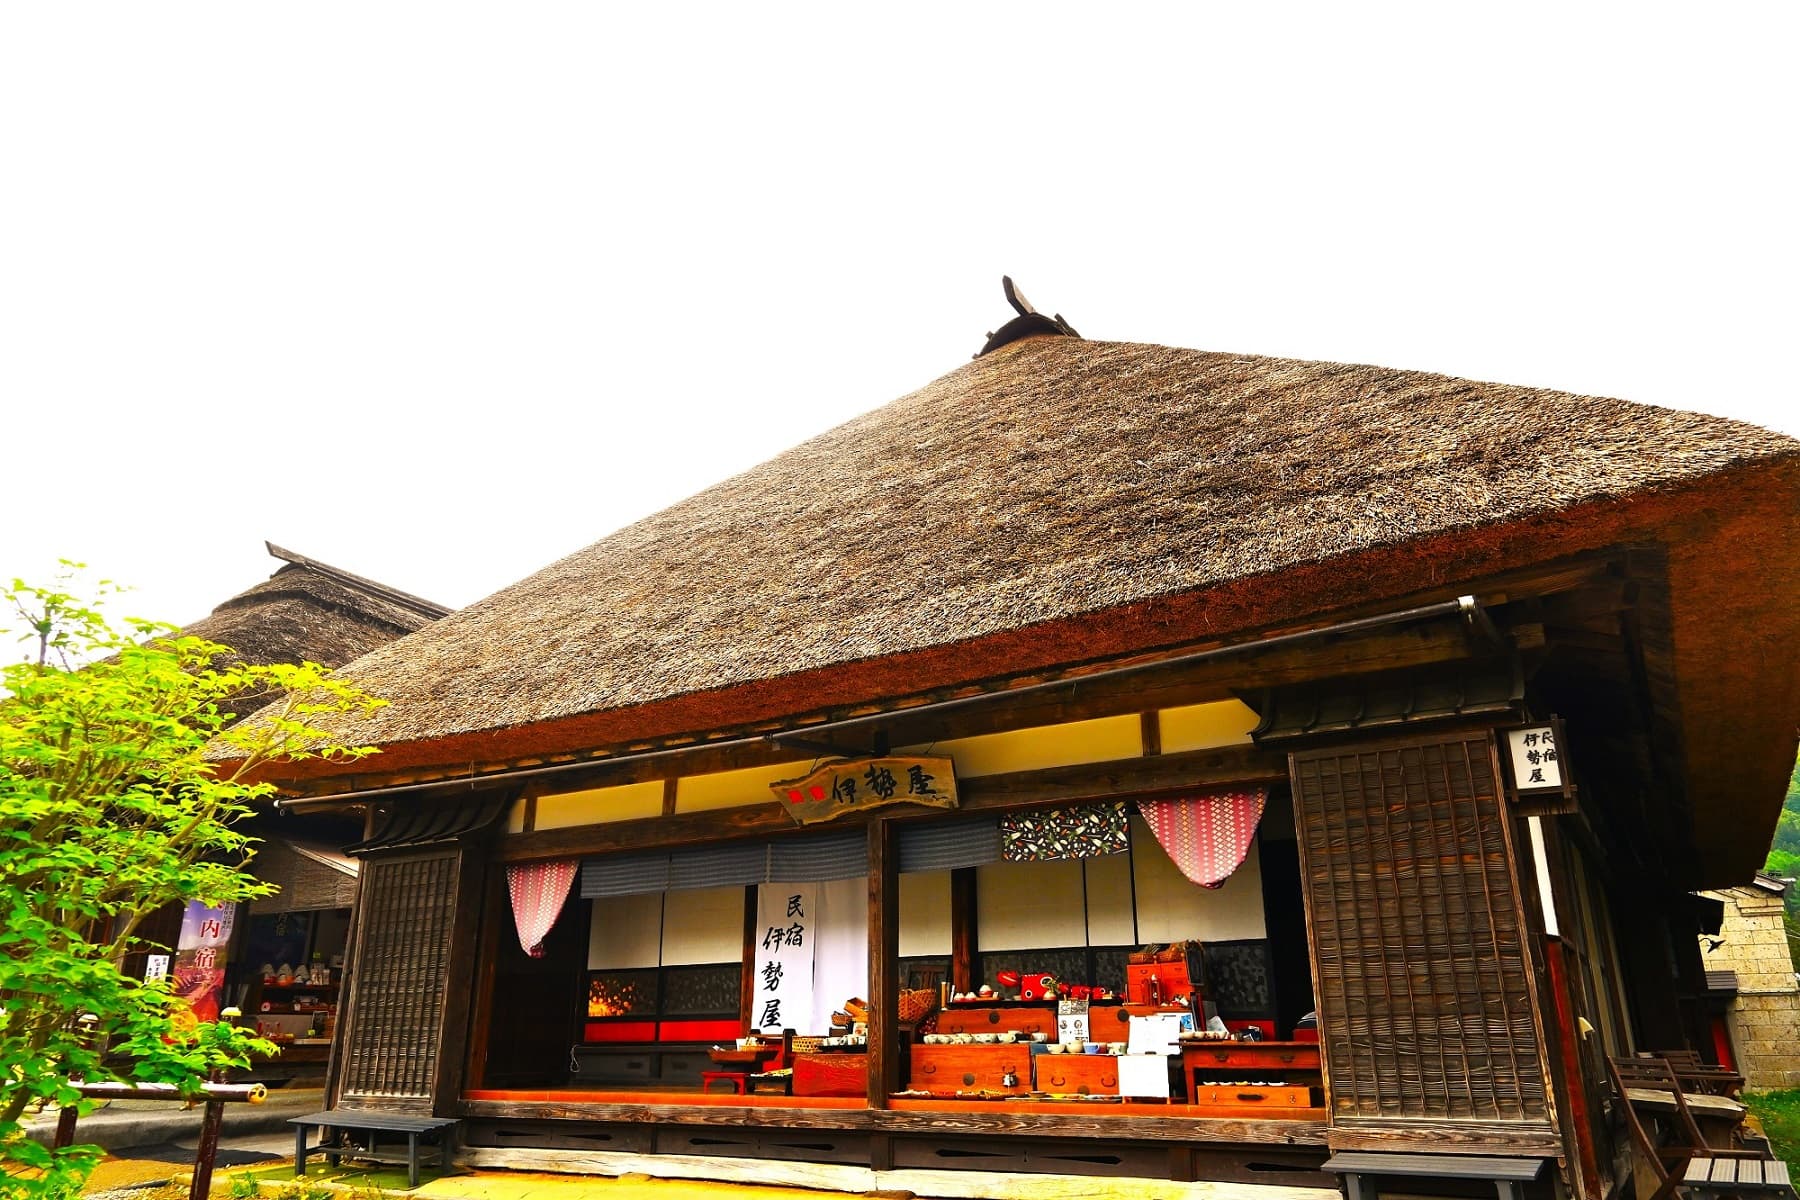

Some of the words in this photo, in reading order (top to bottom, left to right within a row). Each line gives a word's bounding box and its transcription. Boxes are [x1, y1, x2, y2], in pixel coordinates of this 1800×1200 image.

[1523, 733, 1546, 783] 伊勢屋
[1542, 731, 1558, 763] 民宿
[831, 762, 937, 804] 伊勢屋
[195, 905, 223, 968] 内宿
[784, 894, 805, 947] 民宿
[759, 926, 785, 1028] 伊勢屋
